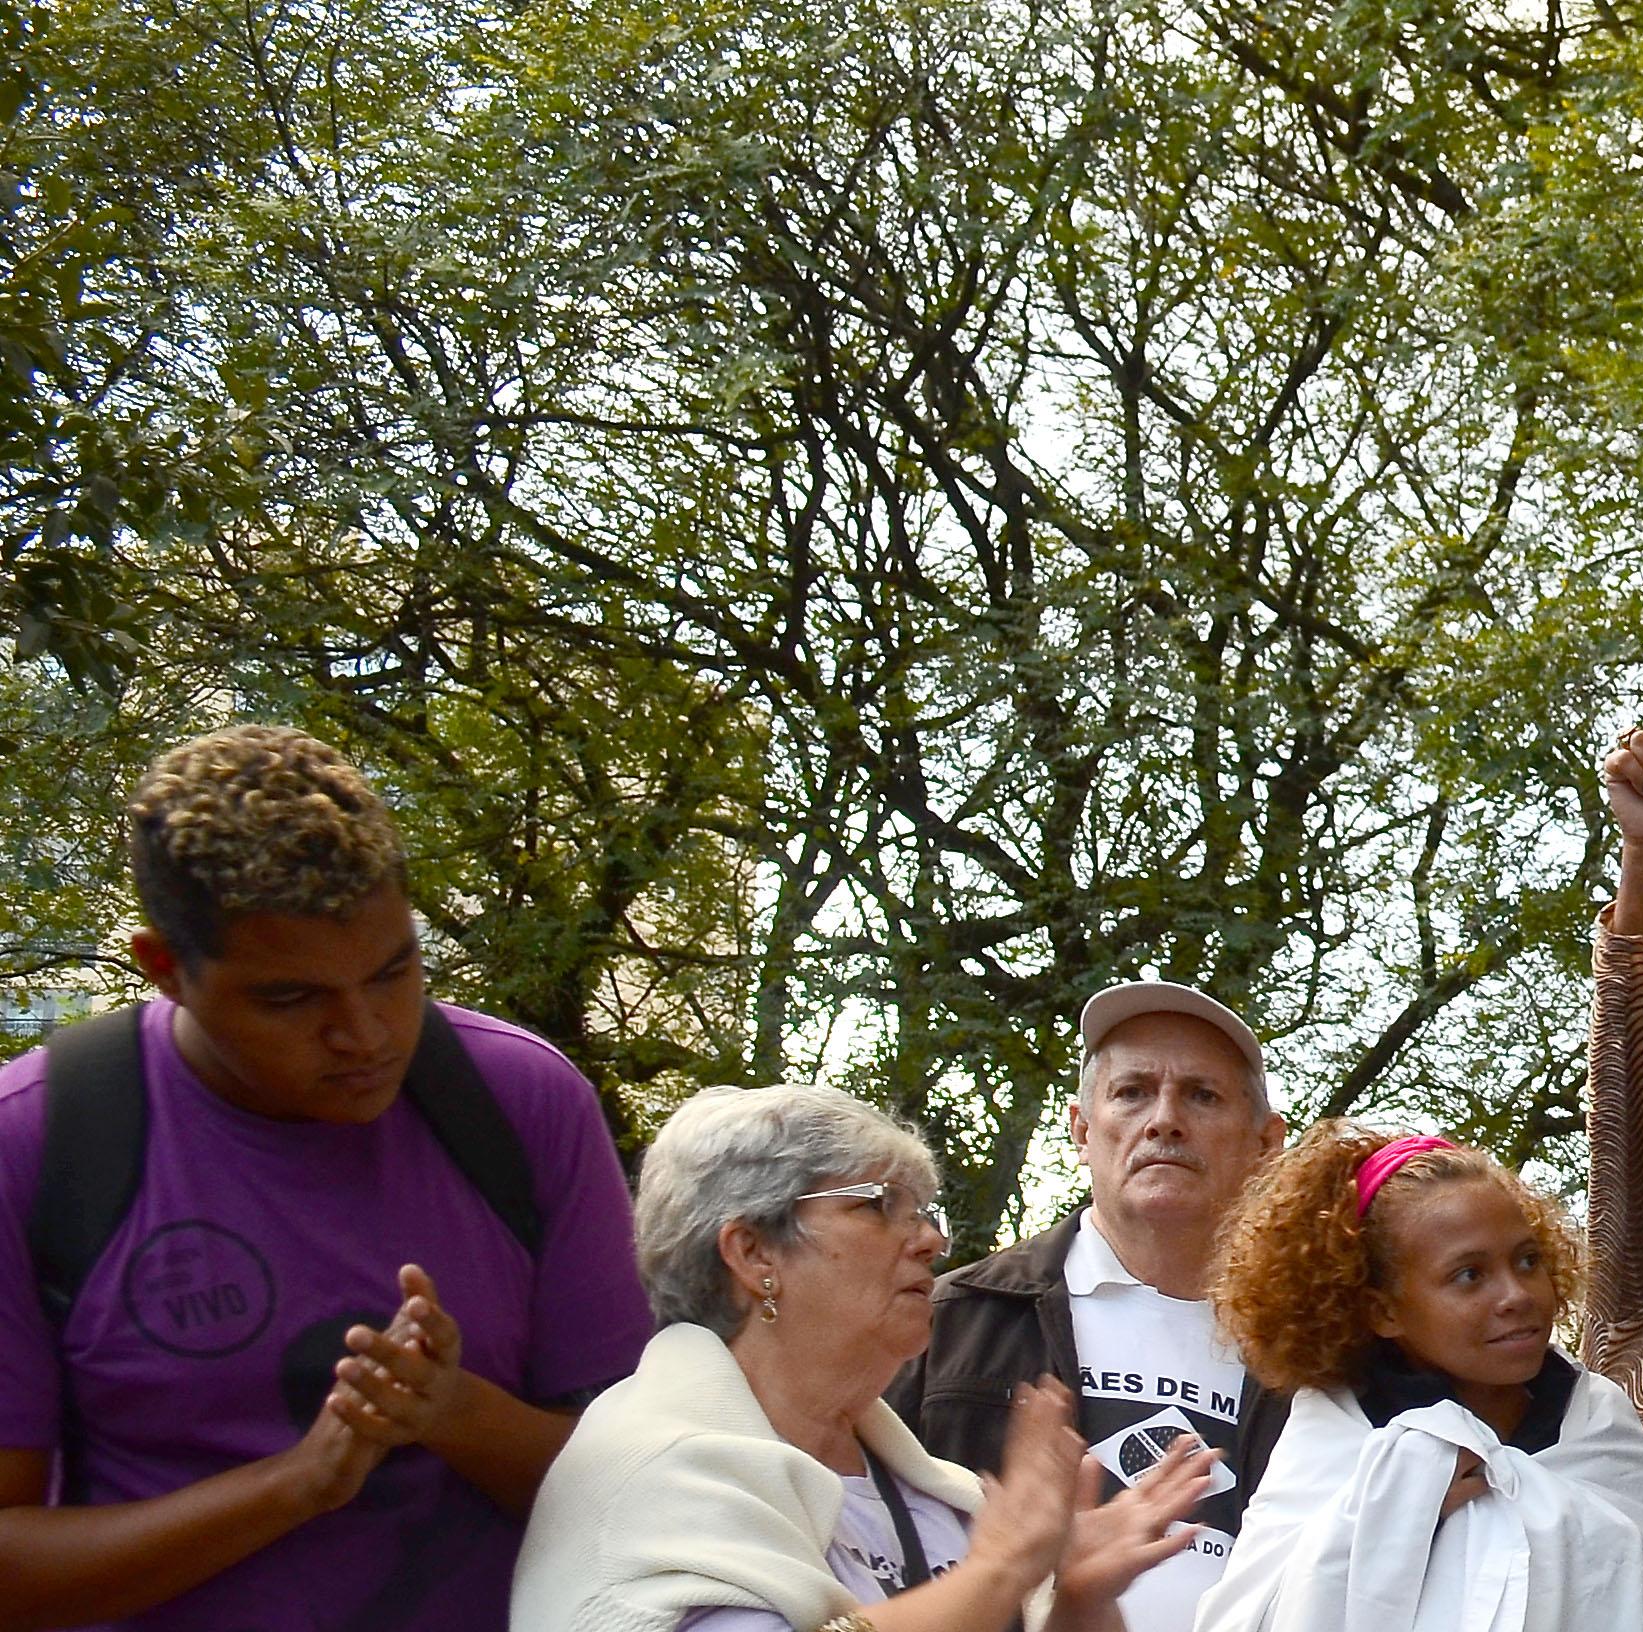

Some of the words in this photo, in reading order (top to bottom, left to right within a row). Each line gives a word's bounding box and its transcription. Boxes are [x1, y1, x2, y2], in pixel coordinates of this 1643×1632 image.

[1080, 1366, 1144, 1394] ÃES
[1157, 1376, 1199, 1404] DE
[1203, 1540, 1224, 1557] DO
